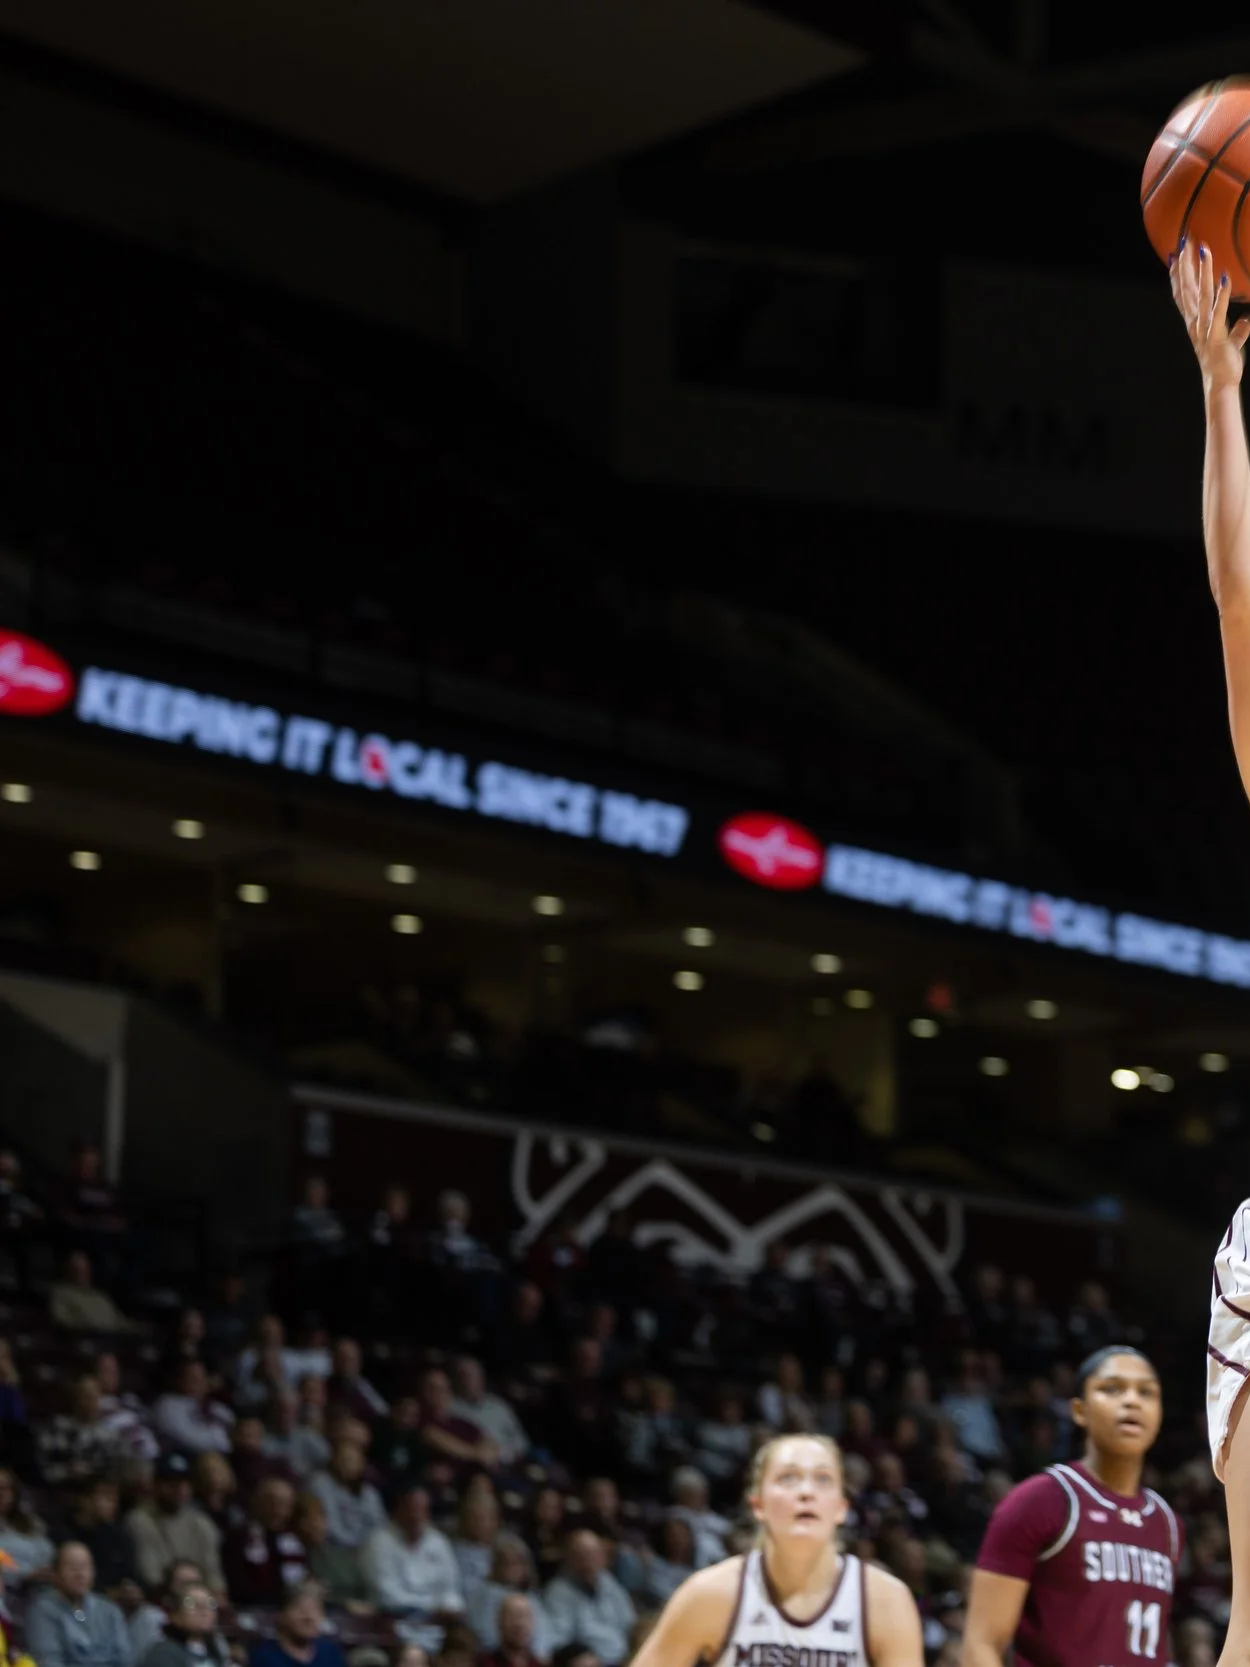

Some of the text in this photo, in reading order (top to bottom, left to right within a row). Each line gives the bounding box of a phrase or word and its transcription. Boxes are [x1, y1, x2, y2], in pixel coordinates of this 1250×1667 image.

[76, 665, 280, 765] KEEPING
[281, 714, 332, 775] IT
[331, 726, 470, 809] LOCAL
[474, 760, 598, 839] SINCE
[1127, 1599, 1160, 1659] 11
